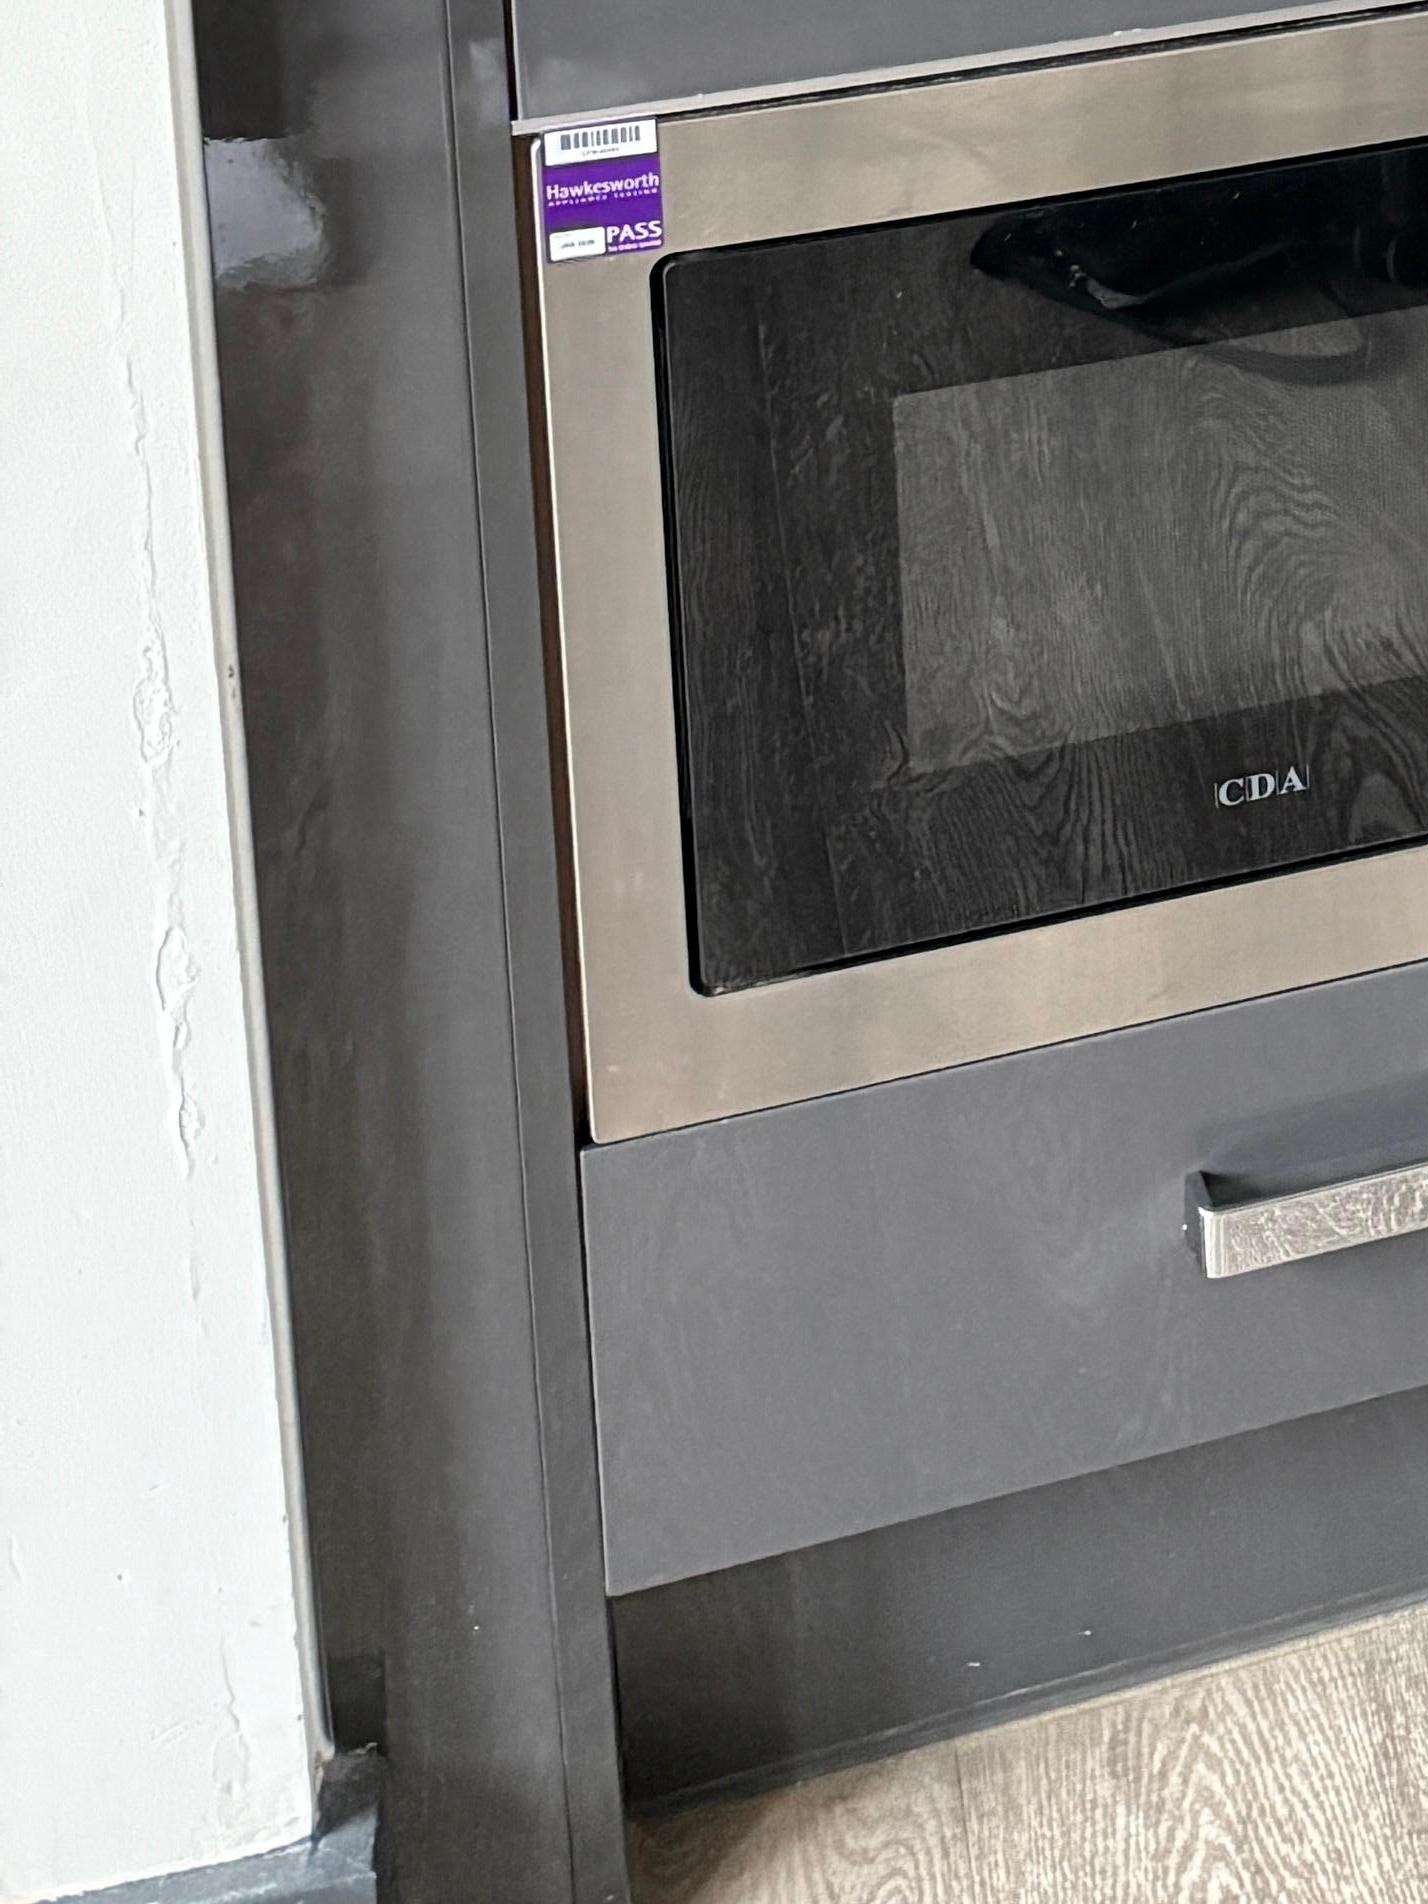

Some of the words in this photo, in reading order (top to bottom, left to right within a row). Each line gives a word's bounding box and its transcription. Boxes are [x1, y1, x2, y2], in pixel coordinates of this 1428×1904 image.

[546, 172, 660, 200] Hawkesworth
[607, 220, 662, 242] PASS
[1218, 765, 1308, 807] CDA
